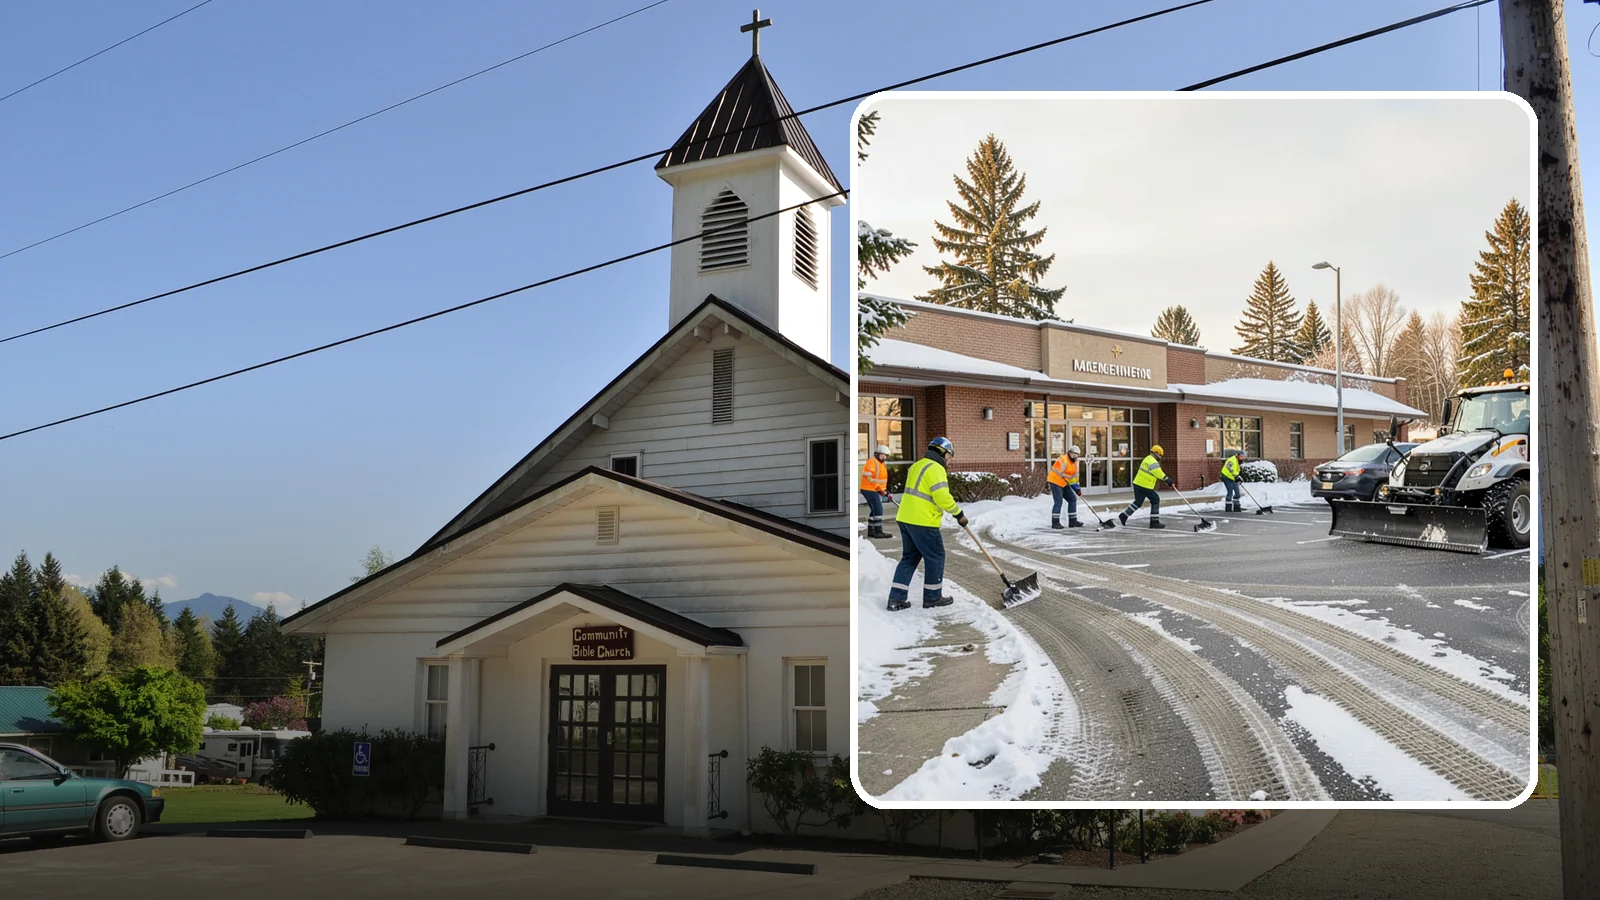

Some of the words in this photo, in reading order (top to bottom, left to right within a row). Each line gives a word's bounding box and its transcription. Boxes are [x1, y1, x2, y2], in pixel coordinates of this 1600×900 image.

[574, 627, 628, 641] Community
[572, 644, 595, 657] Bible
[597, 645, 631, 658] Church
